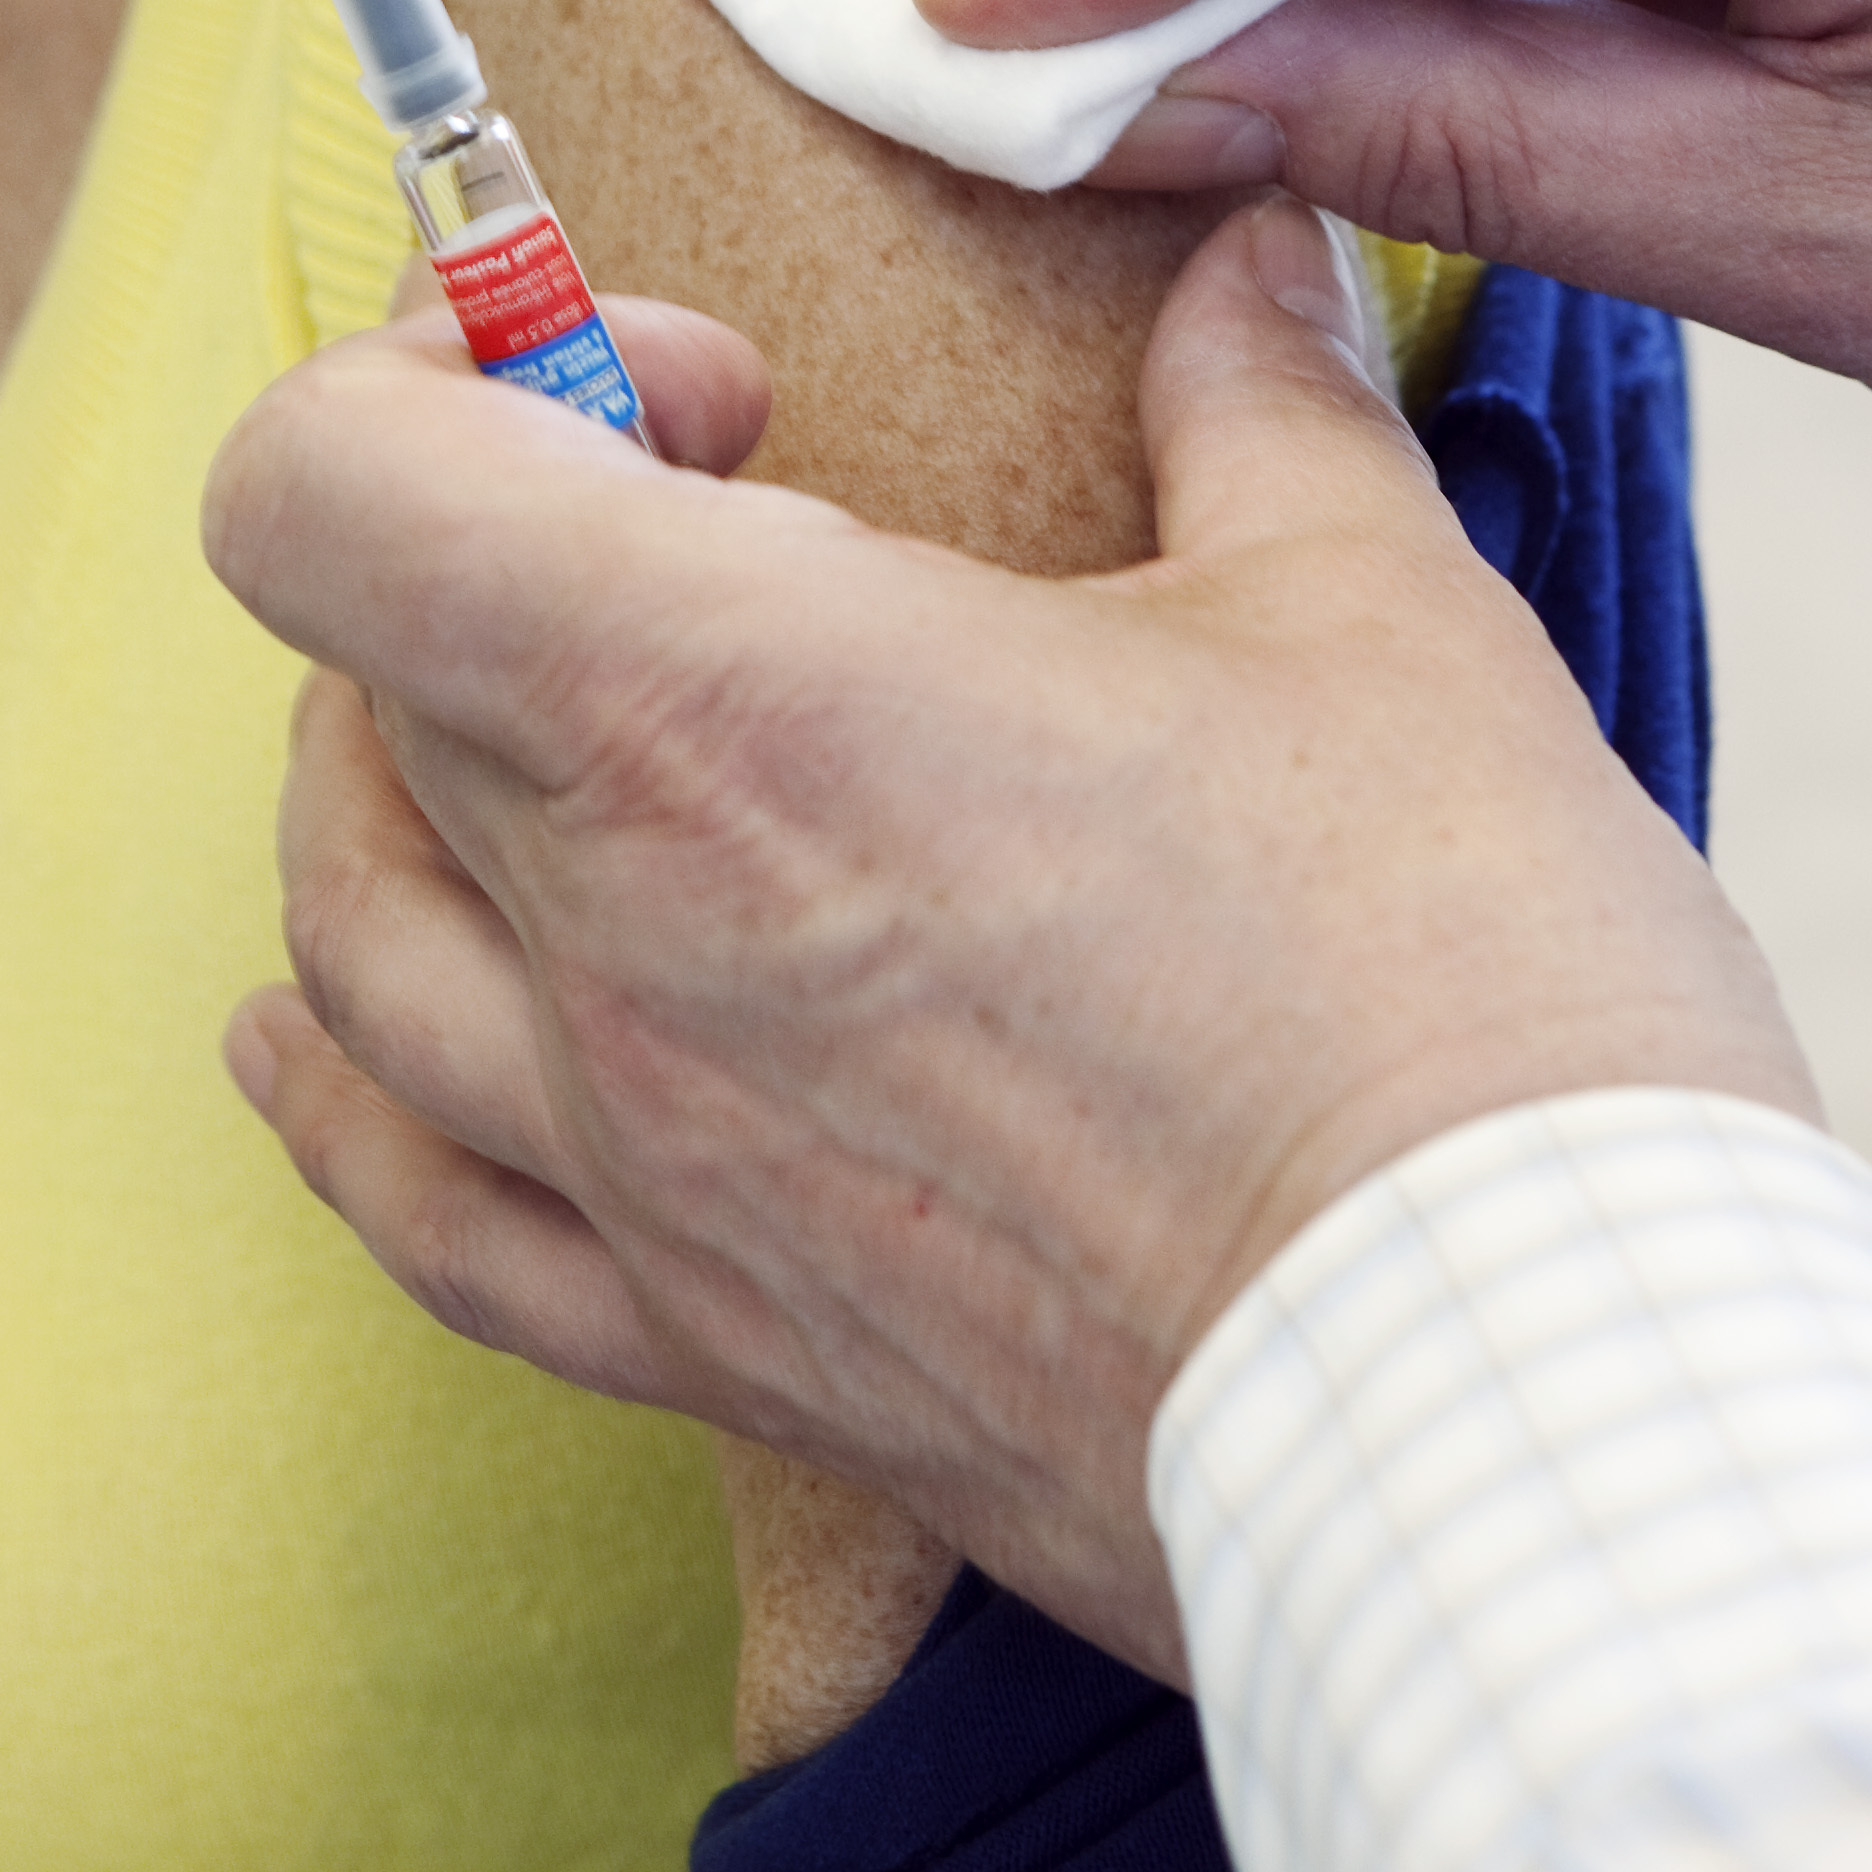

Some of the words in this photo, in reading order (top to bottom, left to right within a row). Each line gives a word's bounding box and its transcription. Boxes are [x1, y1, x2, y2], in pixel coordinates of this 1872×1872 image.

[509, 224, 557, 263] Sanofi
[448, 251, 510, 280] Pasteur
[506, 329, 524, 349] ml
